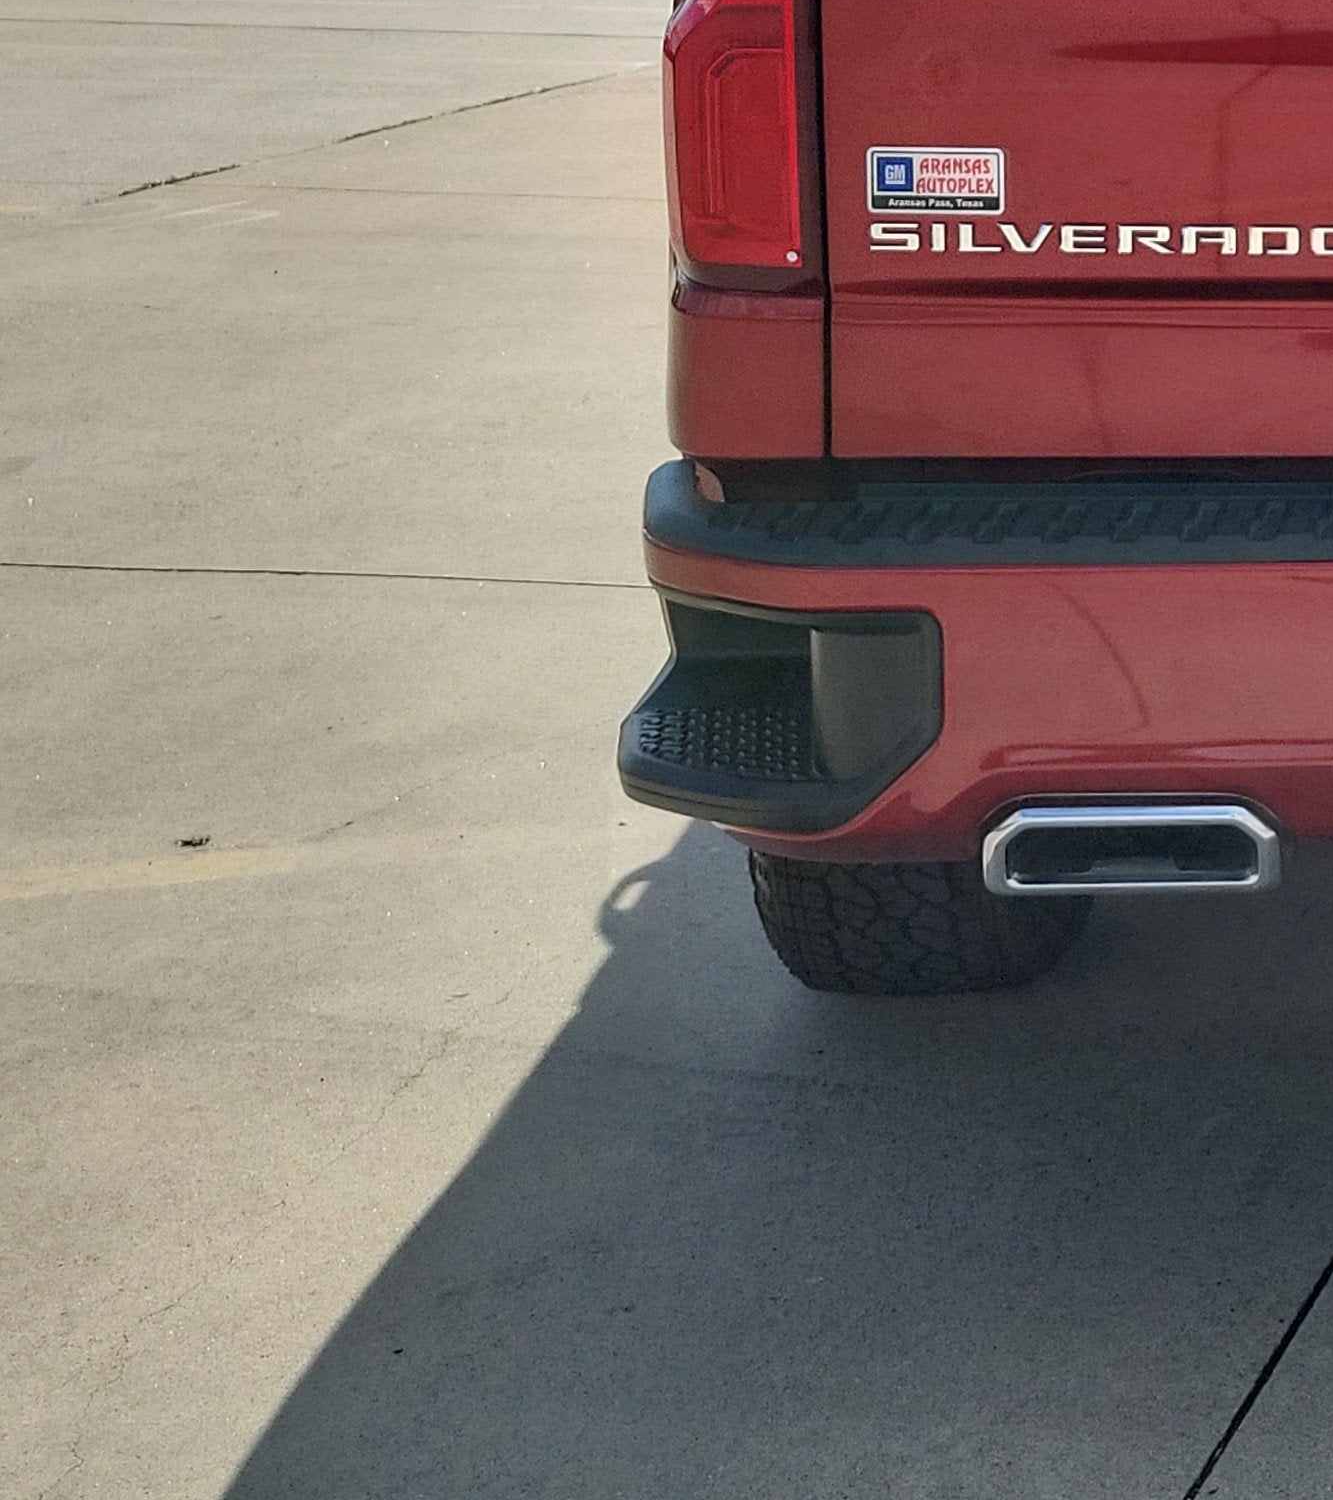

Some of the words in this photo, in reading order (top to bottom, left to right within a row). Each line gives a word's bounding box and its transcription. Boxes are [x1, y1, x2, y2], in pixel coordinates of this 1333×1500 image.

[884, 164, 906, 184] GM
[919, 157, 990, 175] ARANSAS
[916, 178, 994, 194] AUTOPLEX
[888, 198, 926, 207] Aransas
[928, 198, 954, 208] Pass,
[956, 198, 984, 207] Texas
